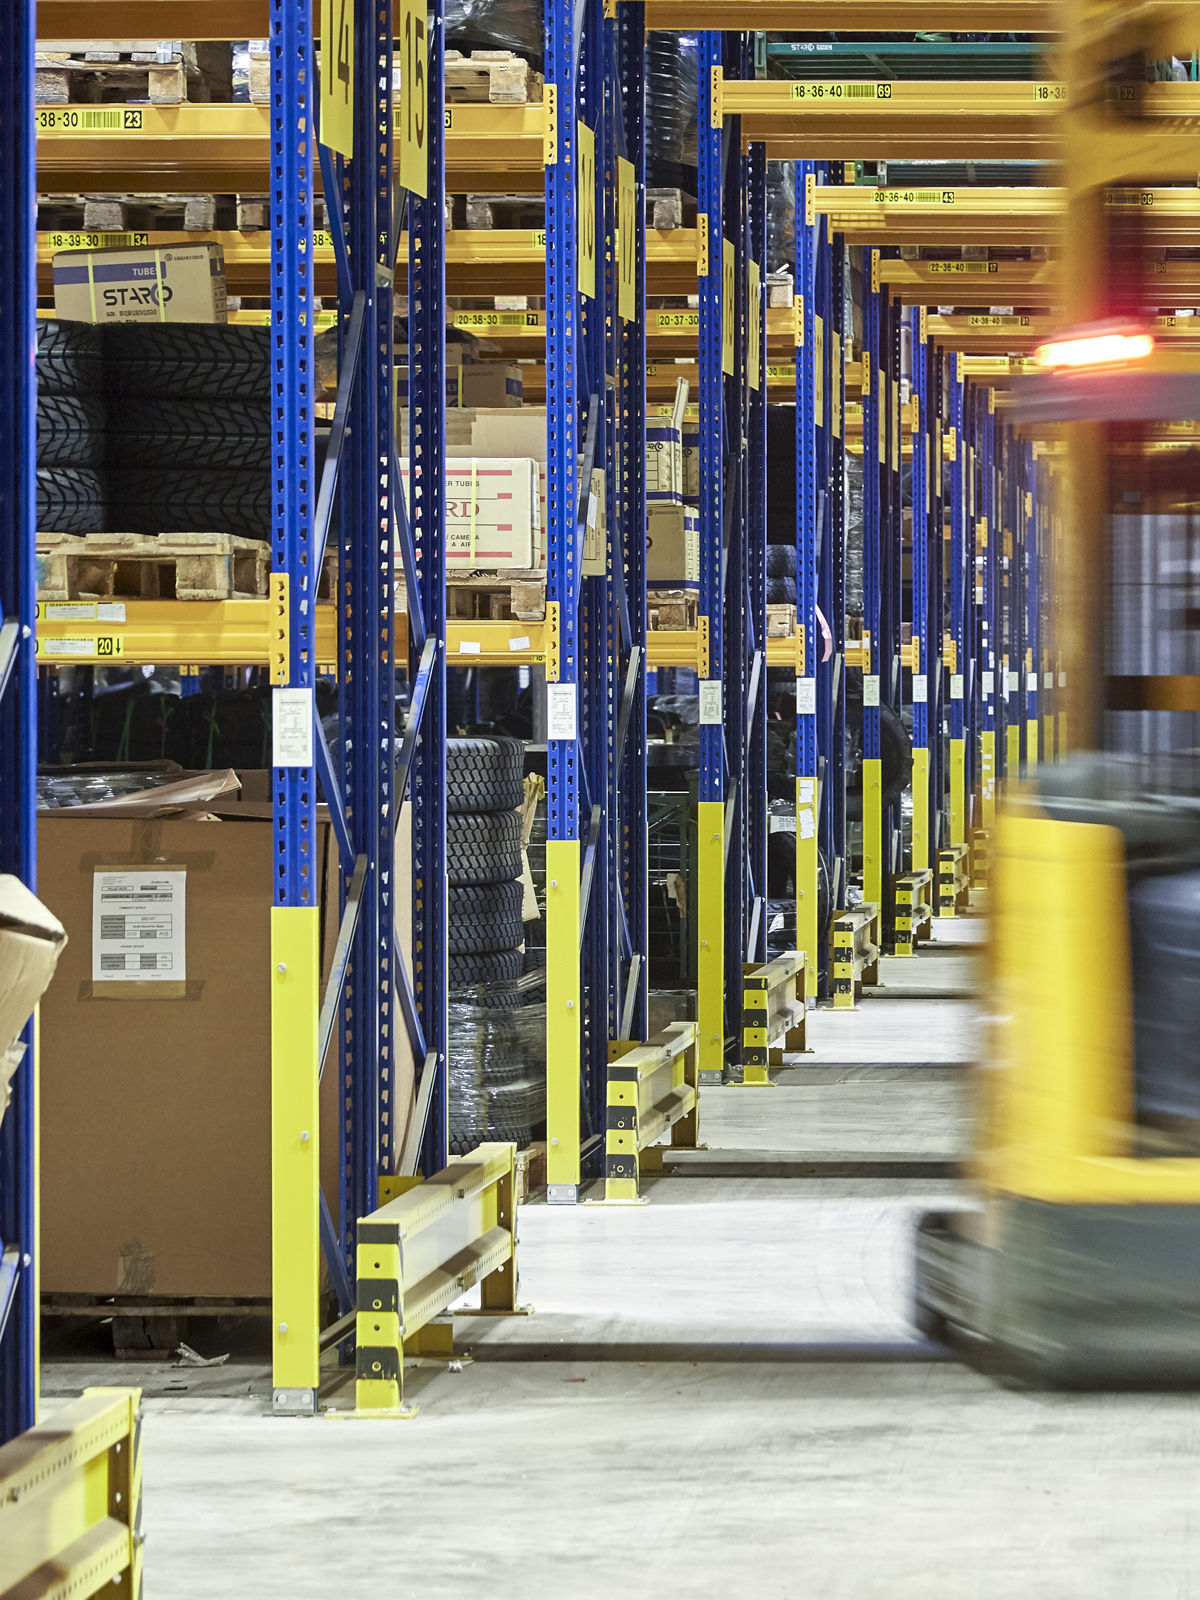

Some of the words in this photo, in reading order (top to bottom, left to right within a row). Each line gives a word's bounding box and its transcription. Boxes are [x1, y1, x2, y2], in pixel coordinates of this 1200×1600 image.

[405, 11, 425, 150] 15
[795, 85, 842, 98] 18-36-40
[878, 85, 891, 98] 69
[125, 111, 141, 127] 23
[874, 192, 914, 202] 20-36-40
[943, 192, 954, 203] 43
[1141, 194, 1153, 204] 06
[52, 234, 98, 246] 18-39-30
[135, 234, 147, 246] 34
[931, 263, 964, 271] 22-36-40
[458, 314, 498, 325] 20-38-30
[527, 314, 538, 325] 71
[659, 315, 698, 326] 20-37-30
[98, 638, 112, 654] 20
